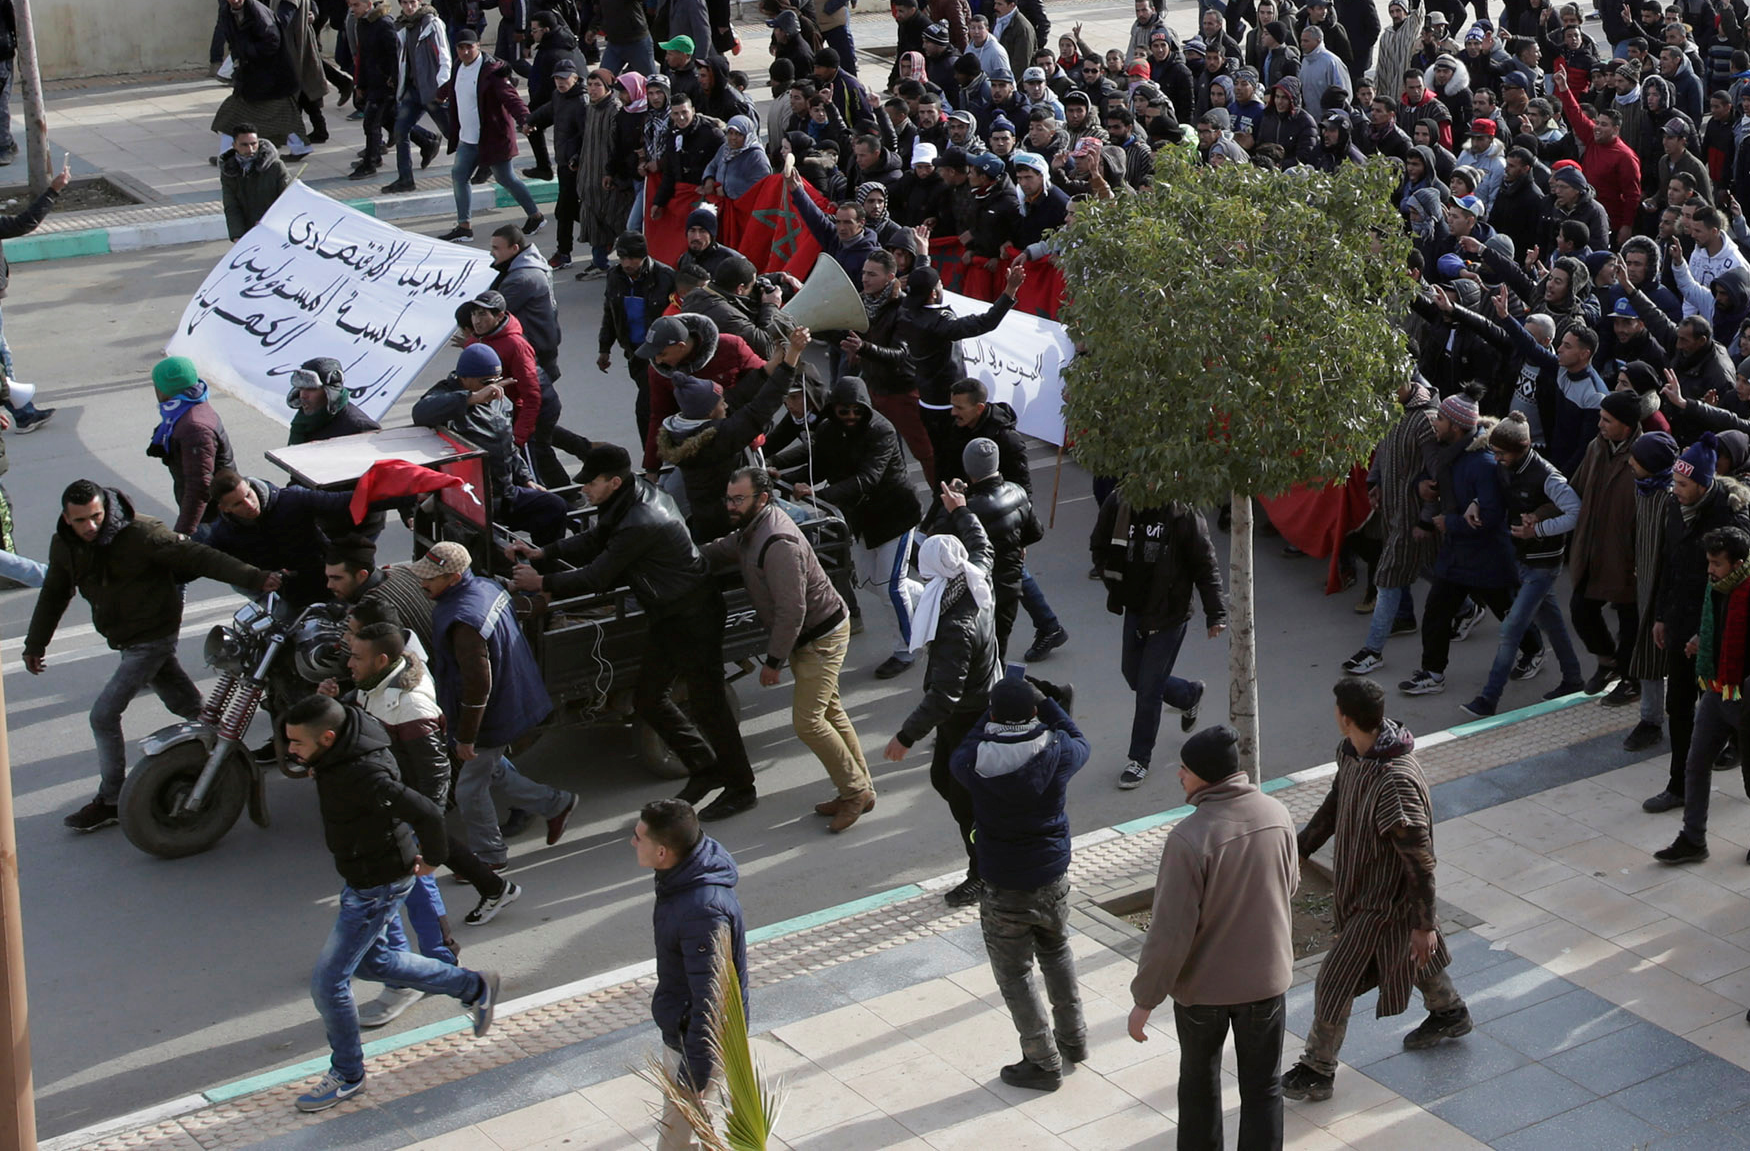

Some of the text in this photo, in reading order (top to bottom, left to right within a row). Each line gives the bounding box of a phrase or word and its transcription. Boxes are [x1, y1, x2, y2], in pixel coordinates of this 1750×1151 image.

[398, 245, 478, 299] البديل
[335, 290, 422, 354] محاسبة
[1006, 352, 1043, 386] الموت
